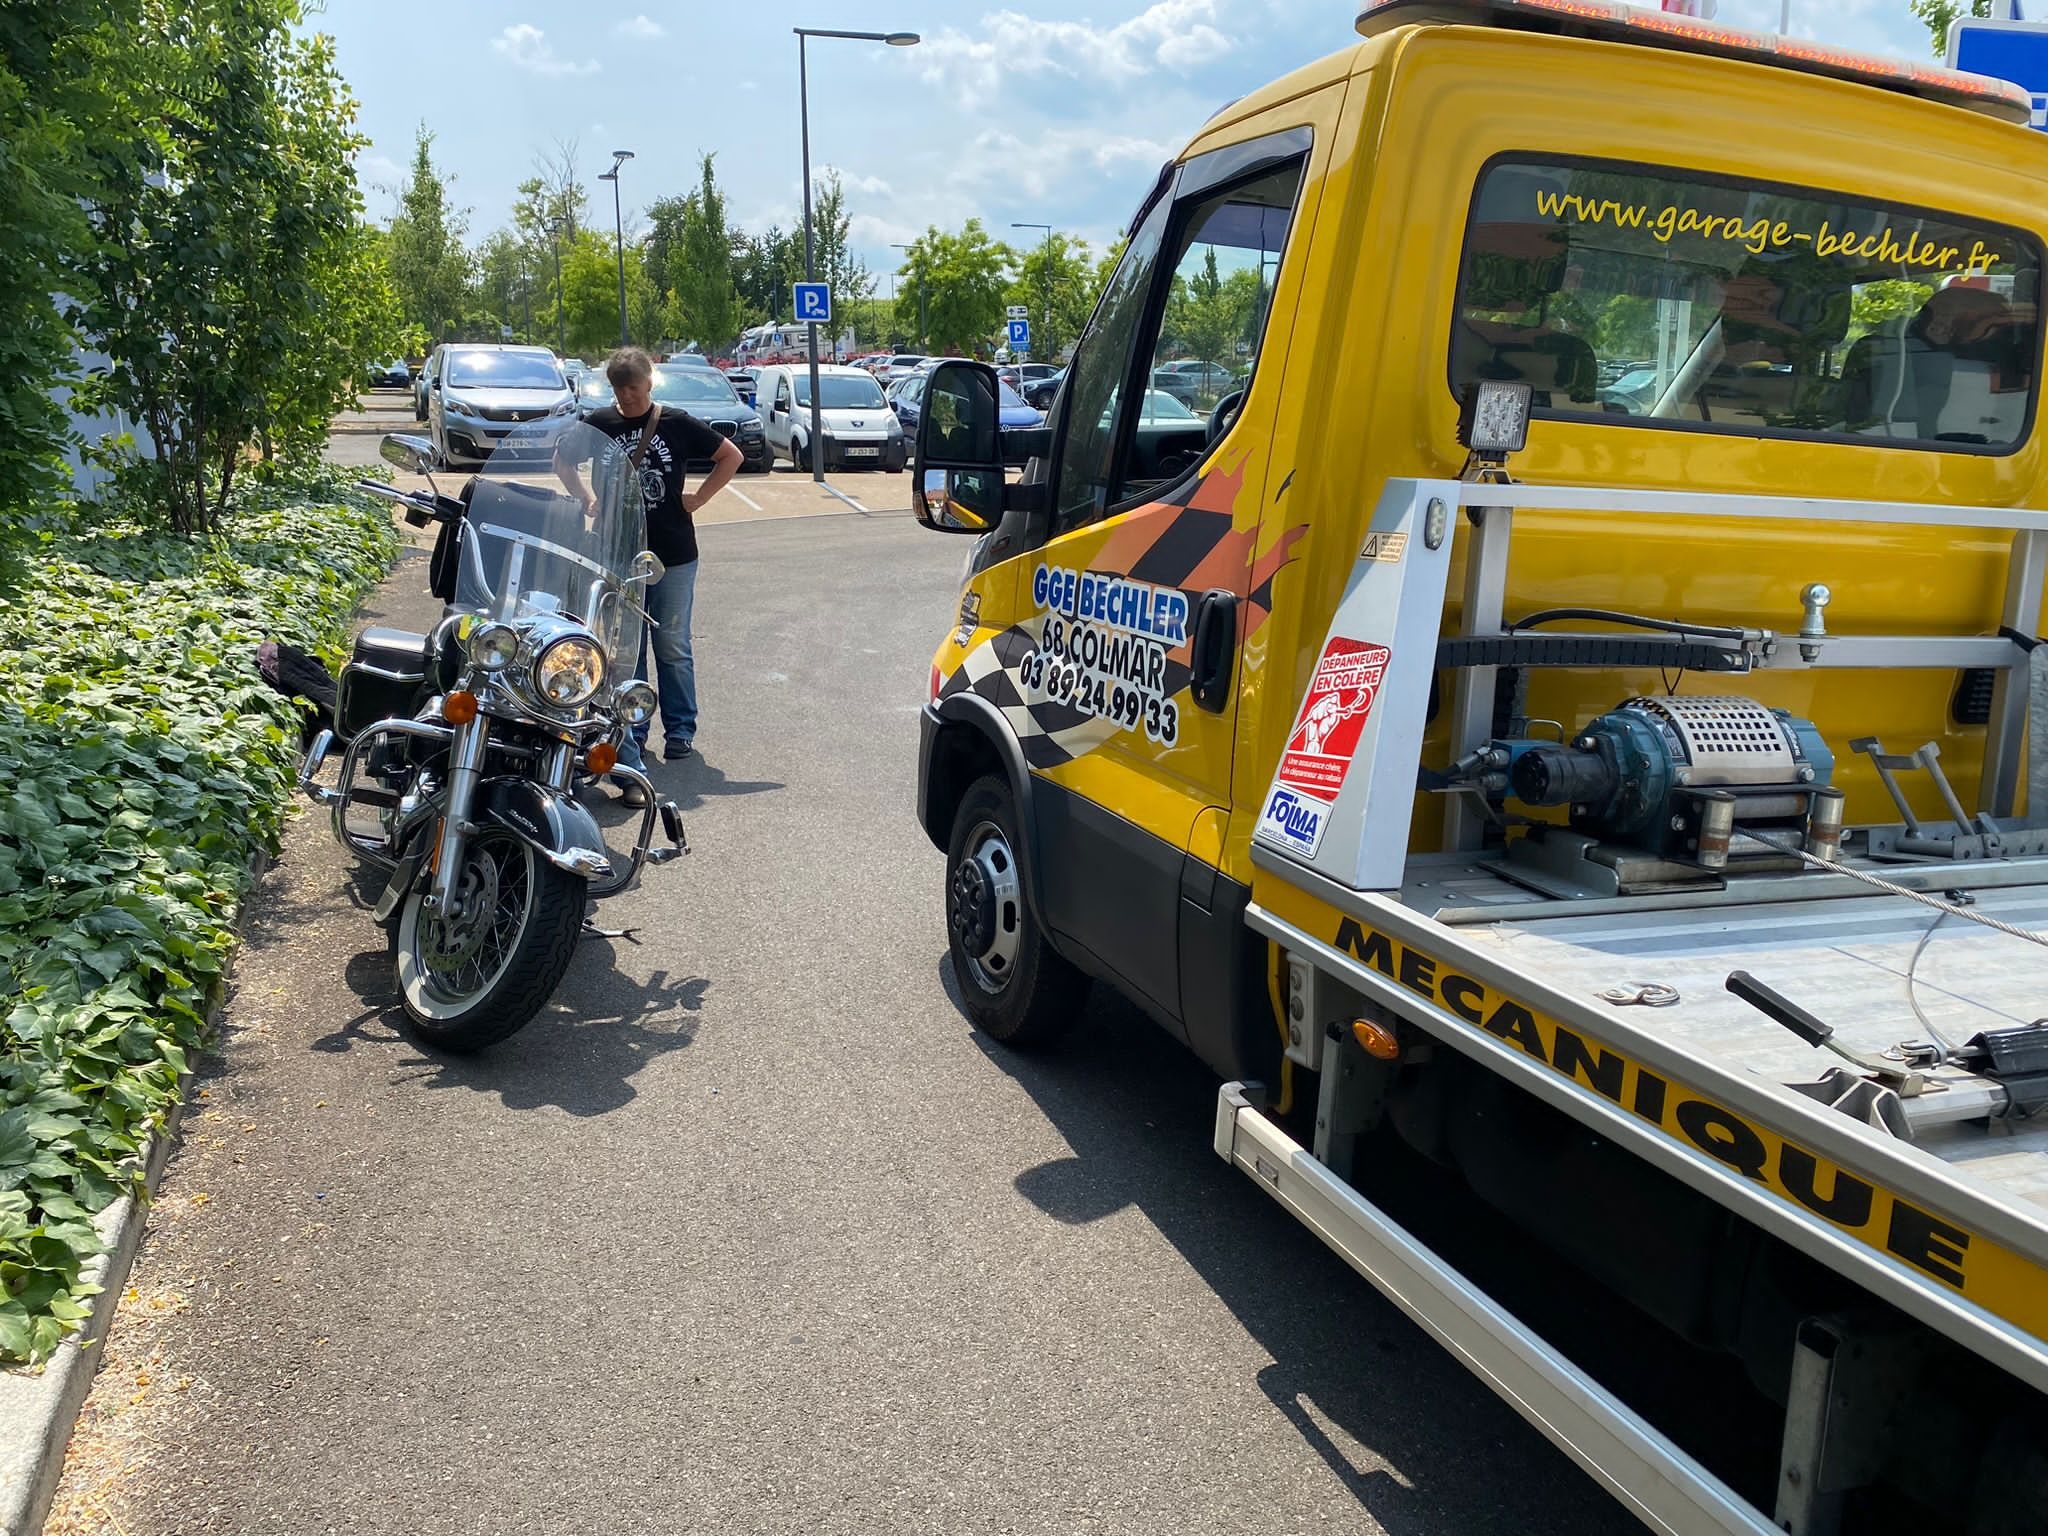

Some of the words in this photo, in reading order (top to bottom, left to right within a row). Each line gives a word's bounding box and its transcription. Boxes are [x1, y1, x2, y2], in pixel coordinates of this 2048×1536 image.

[1537, 191, 1999, 281] www.garage-bechler.fr
[804, 291, 819, 313] P
[1014, 325, 1023, 338] P
[600, 428, 673, 466] HARLEY-DADSON
[1034, 567, 1075, 613] GGE
[1079, 577, 1186, 642] BECHLER
[1043, 618, 1063, 656] 68
[1070, 626, 1163, 692] COLMAR
[1317, 676, 1331, 690] EN
[1333, 666, 1380, 688] COLÈRE
[1322, 650, 1386, 670] DÉPANNEURS
[1021, 655, 1043, 690] 03
[1047, 665, 1074, 700] 89
[1112, 686, 1140, 727] 99
[1147, 699, 1176, 742] 33
[1333, 915, 1970, 1290] MECANIQUE
